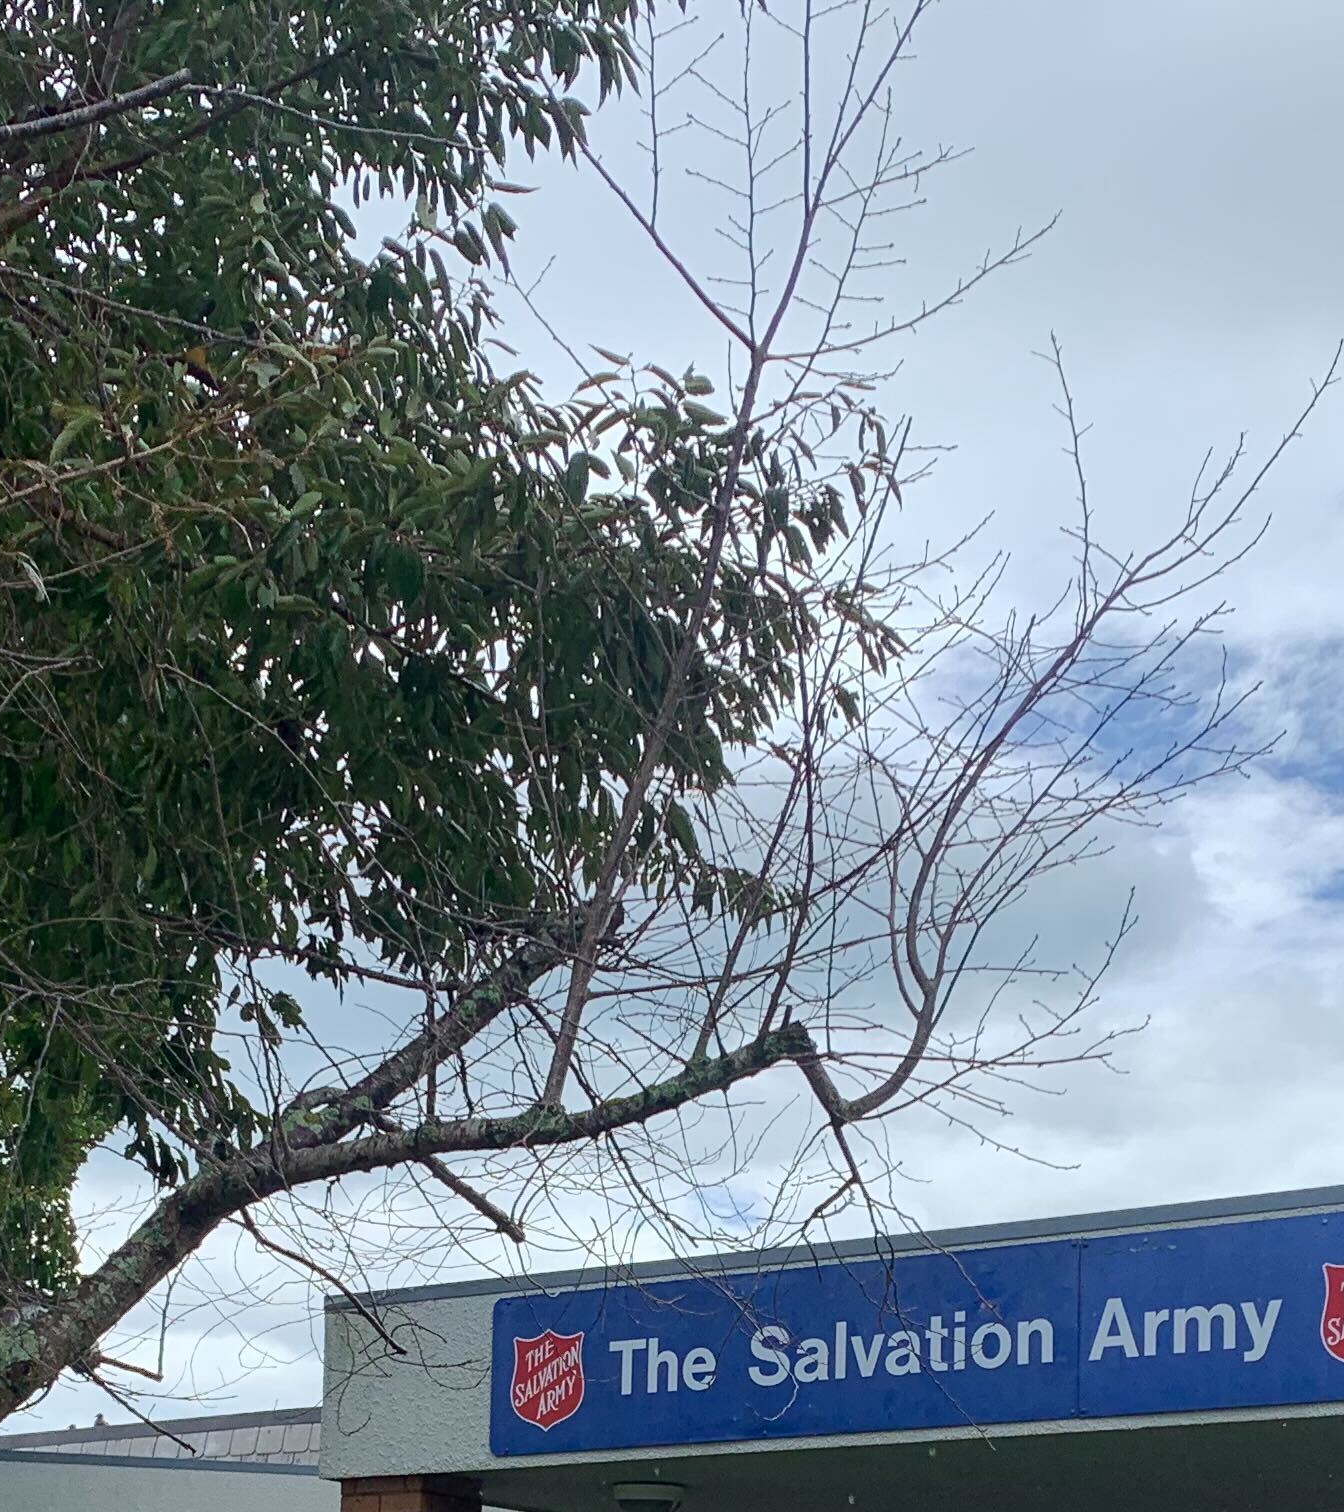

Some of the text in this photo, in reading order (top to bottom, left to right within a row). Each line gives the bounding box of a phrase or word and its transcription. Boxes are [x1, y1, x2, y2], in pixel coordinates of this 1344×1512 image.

[515, 1341, 580, 1408] SALVATION
[525, 1338, 555, 1373] THE
[609, 1297, 1283, 1396] The Salvation Army
[536, 1370, 577, 1420] ARMY
